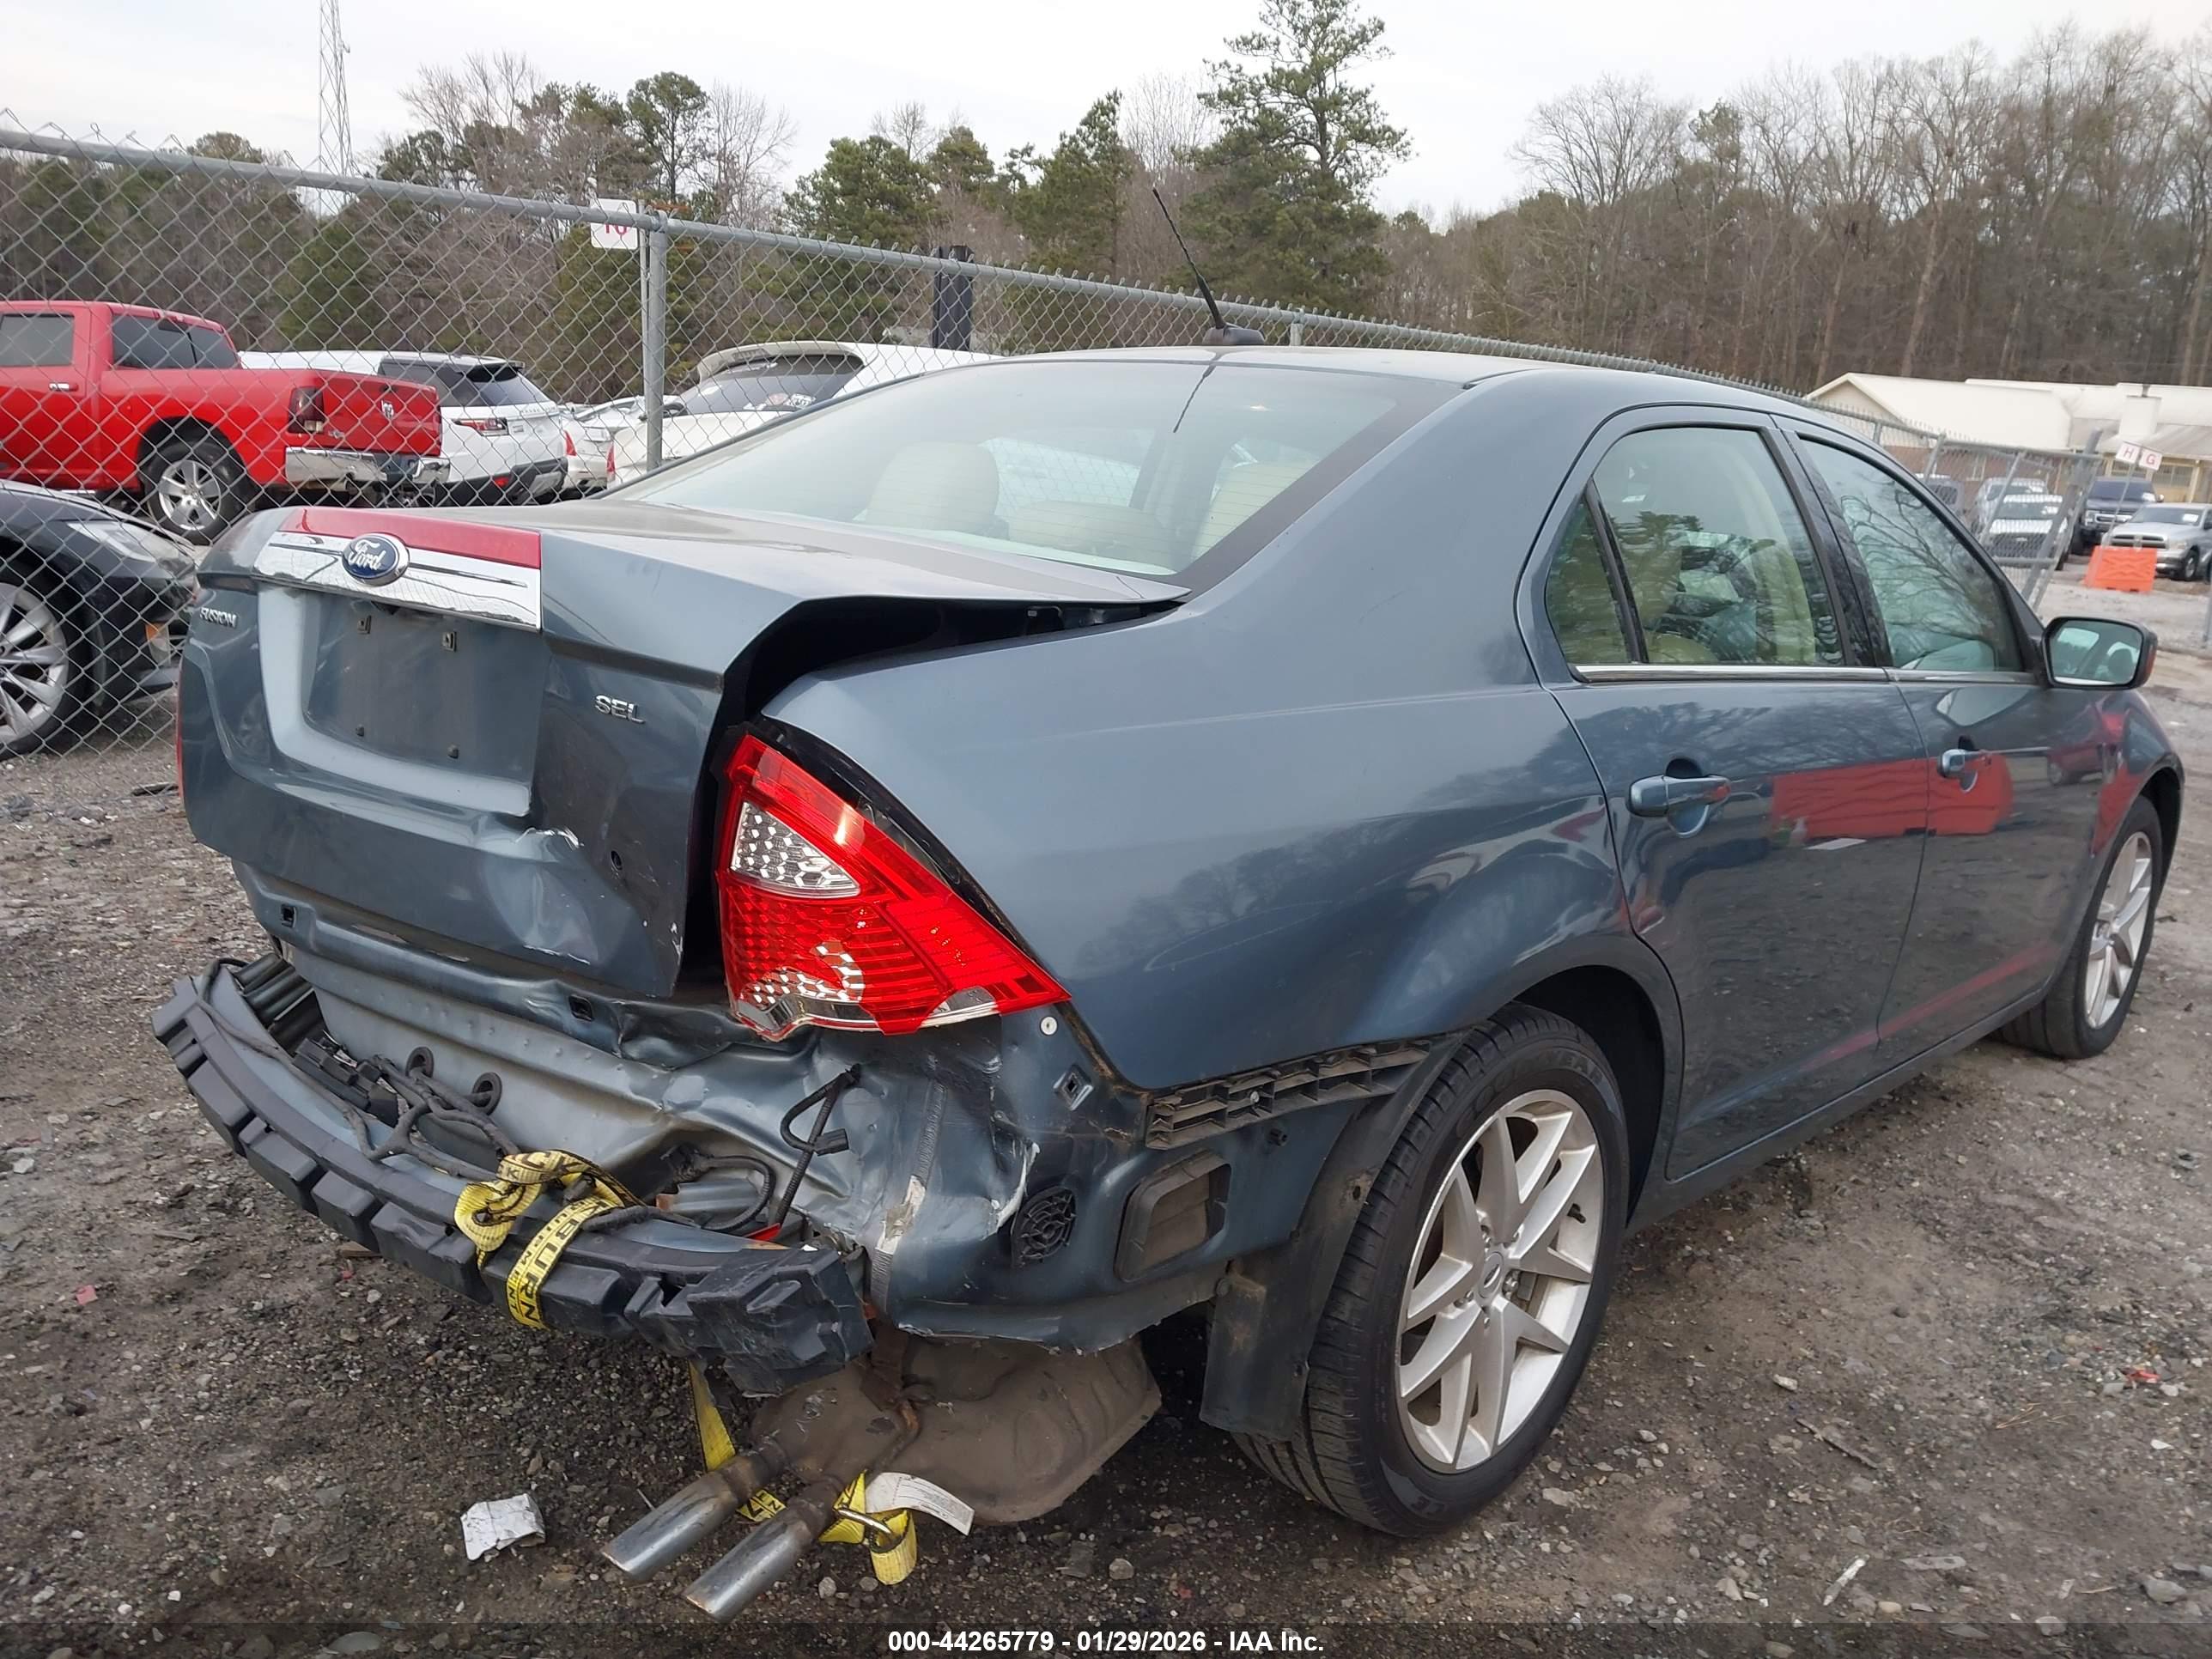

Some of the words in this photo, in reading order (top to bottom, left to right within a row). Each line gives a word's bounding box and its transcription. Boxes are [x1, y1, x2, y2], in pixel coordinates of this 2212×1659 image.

[2124, 447, 2136, 459] H
[2147, 453, 2157, 465] G
[348, 539, 386, 571] Ford
[595, 695, 644, 723] SEL
